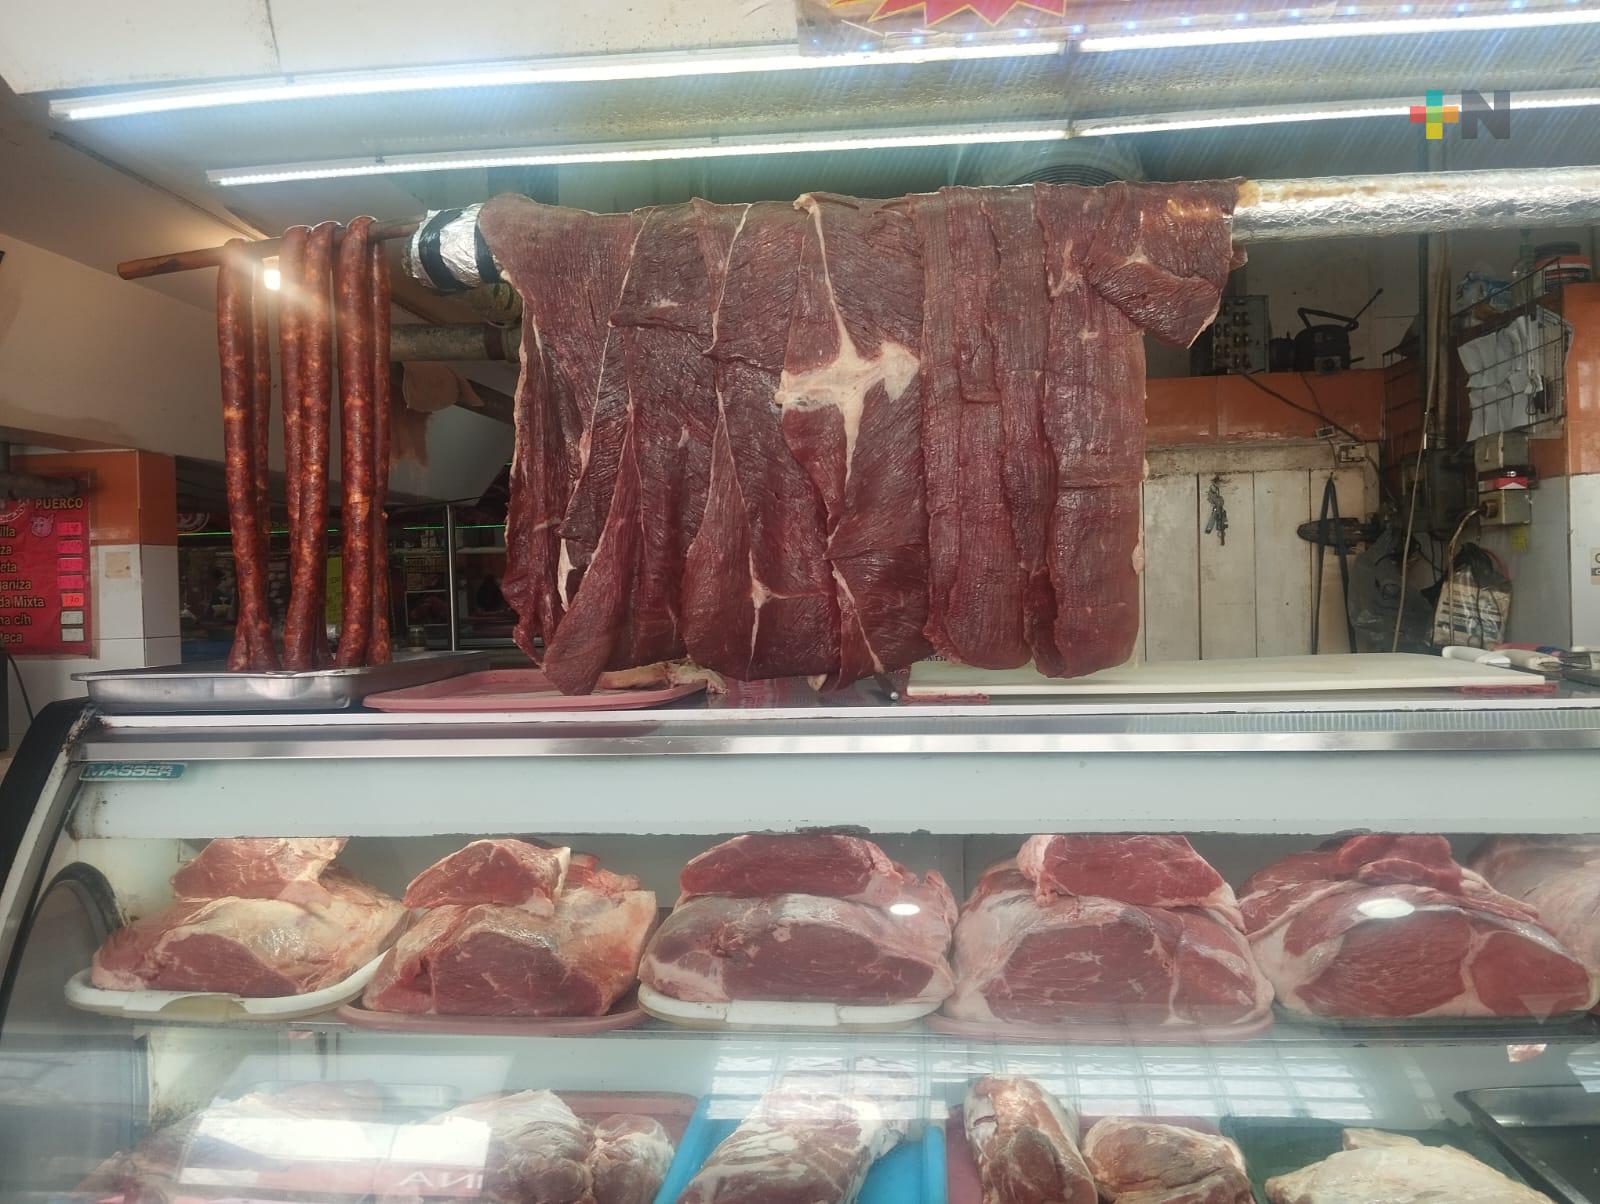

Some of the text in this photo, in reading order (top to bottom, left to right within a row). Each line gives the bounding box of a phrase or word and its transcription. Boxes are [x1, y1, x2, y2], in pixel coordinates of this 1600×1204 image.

[35, 498, 83, 509] PUERCO
[0, 578, 32, 592] aniza
[14, 596, 45, 608] Mixta
[85, 764, 173, 777] MASSER
